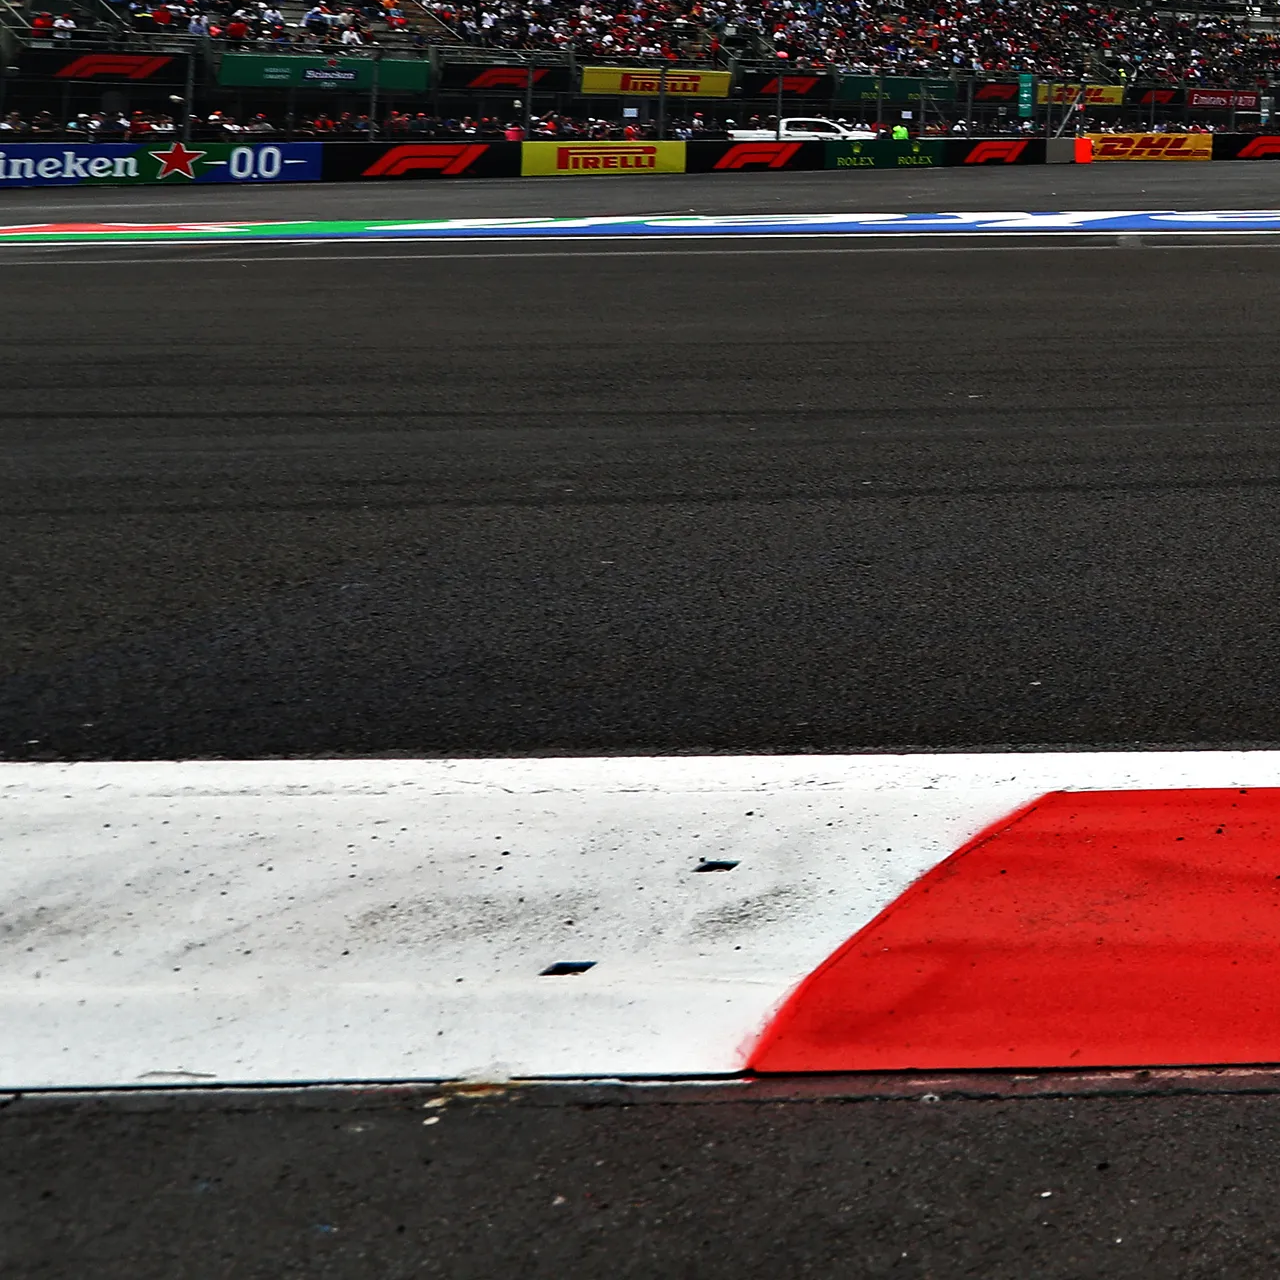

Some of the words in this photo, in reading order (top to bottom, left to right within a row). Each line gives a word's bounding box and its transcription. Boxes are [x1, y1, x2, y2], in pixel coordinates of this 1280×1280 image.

[620, 73, 702, 93] PIRELLI
[1098, 136, 1195, 157] DHL
[557, 145, 658, 169] PIRELLI
[836, 156, 875, 167] ROLEX
[898, 155, 933, 166] ROLEX
